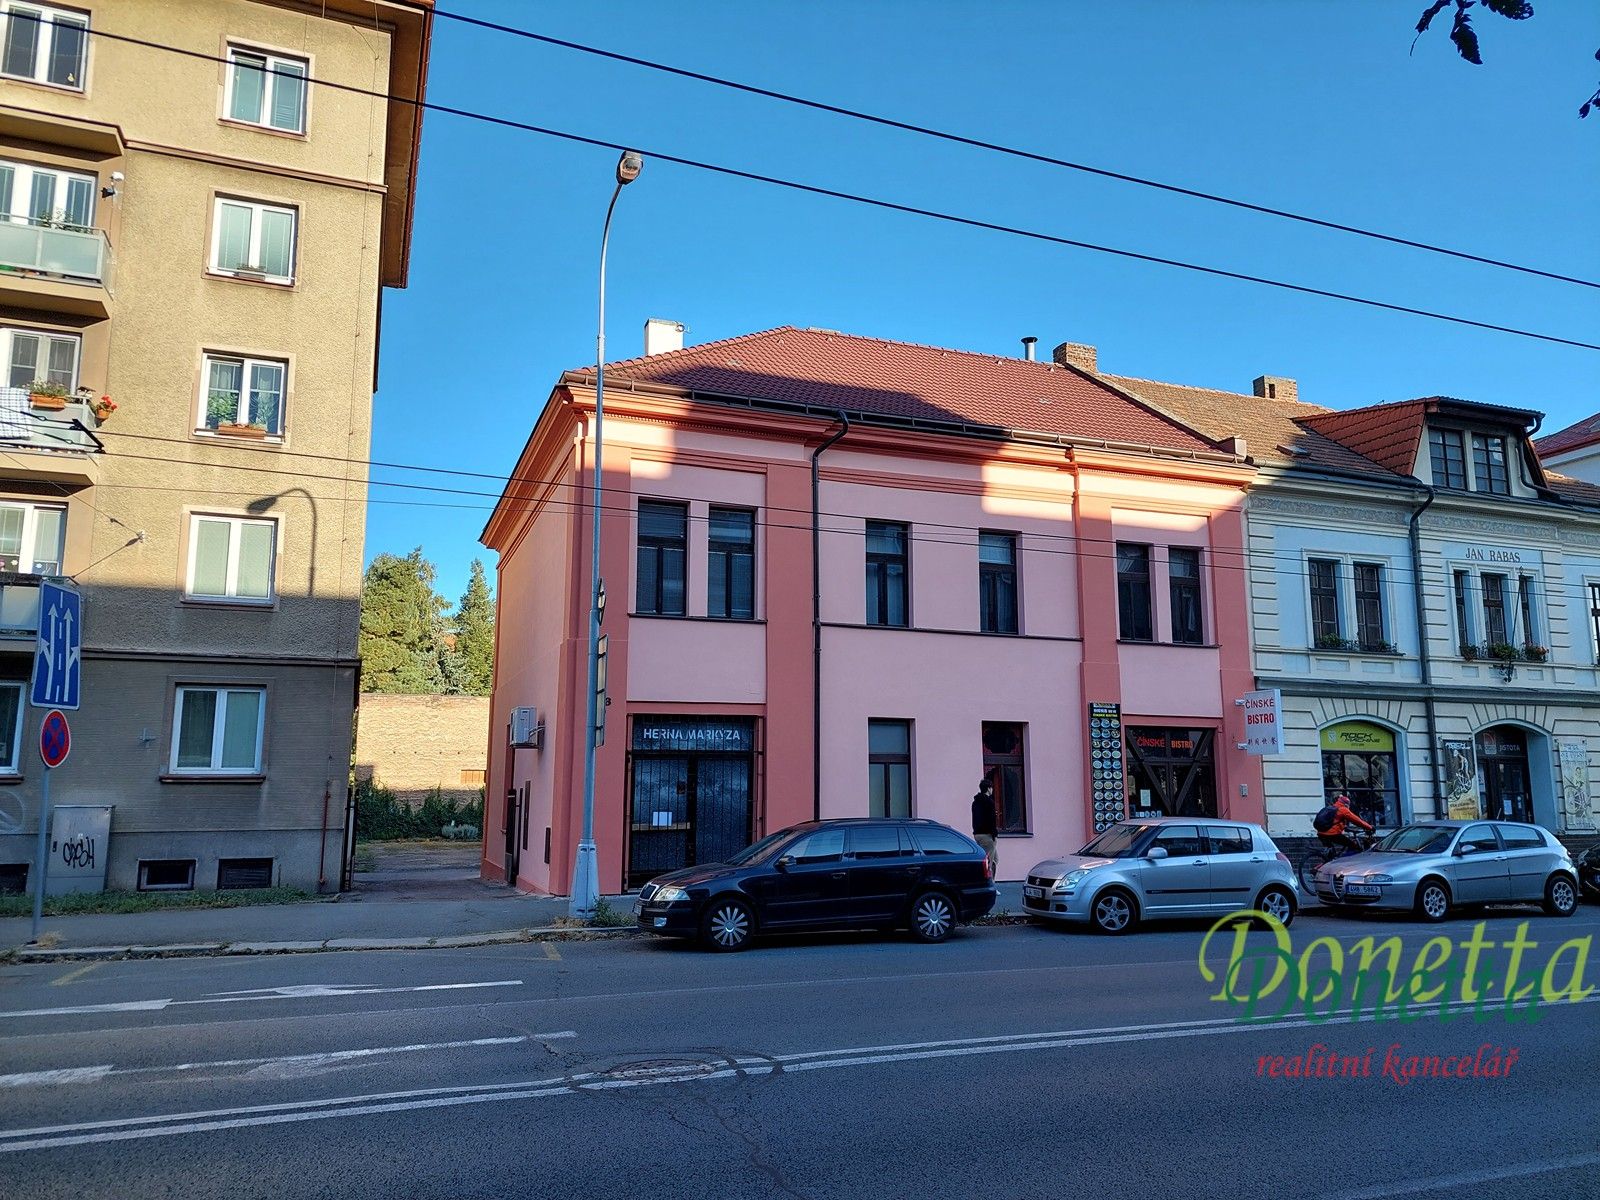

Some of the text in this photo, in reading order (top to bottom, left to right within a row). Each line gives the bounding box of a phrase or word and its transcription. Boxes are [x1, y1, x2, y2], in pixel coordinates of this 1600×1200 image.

[1465, 547, 1521, 563] JAN RABAS
[1245, 697, 1275, 709] ČÍNSKÉ
[1247, 712, 1275, 725] BISTRO
[643, 727, 740, 740] HERNA MARKÝZA
[1340, 732, 1373, 740] ROCK
[1171, 740, 1194, 749] BISTRO
